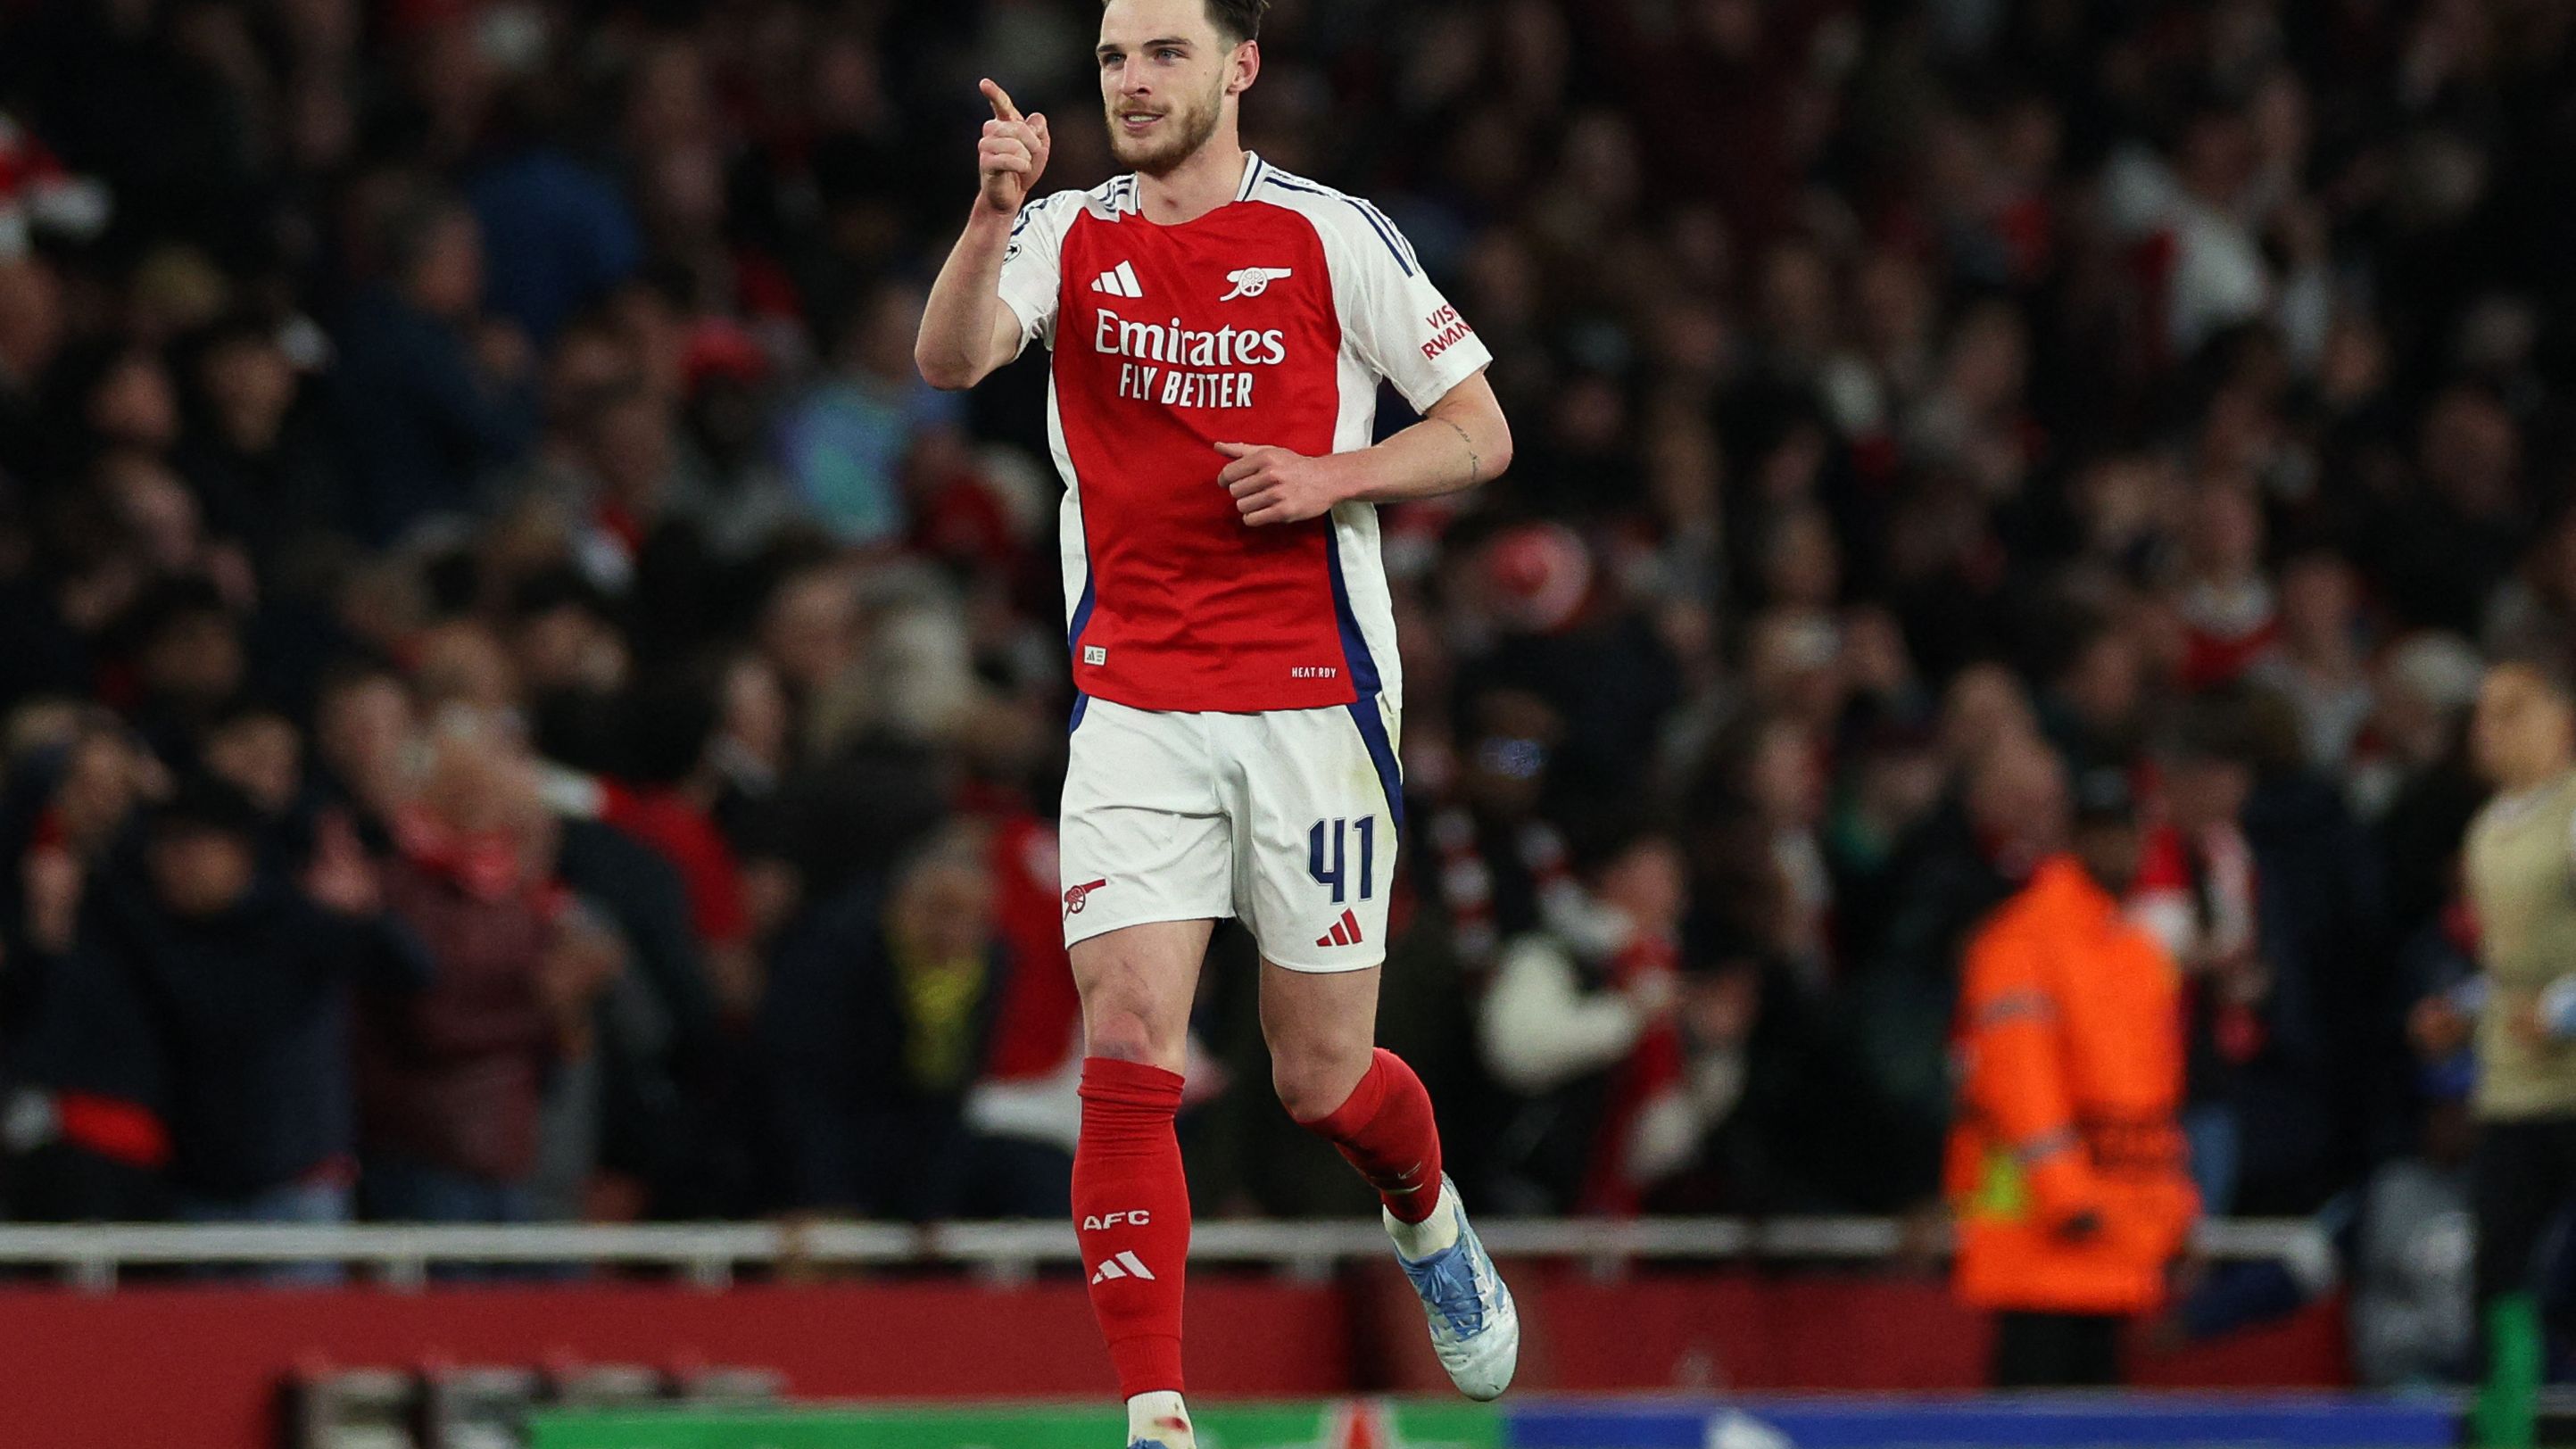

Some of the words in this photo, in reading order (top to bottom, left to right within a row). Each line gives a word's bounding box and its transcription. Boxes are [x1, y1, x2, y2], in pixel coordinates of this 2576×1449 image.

[1095, 308, 1286, 367] Emirates
[1119, 362, 1158, 401] FLY
[1161, 370, 1254, 409] BETTER
[1307, 815, 1375, 906] 41
[1082, 1209, 1150, 1230] AFC
